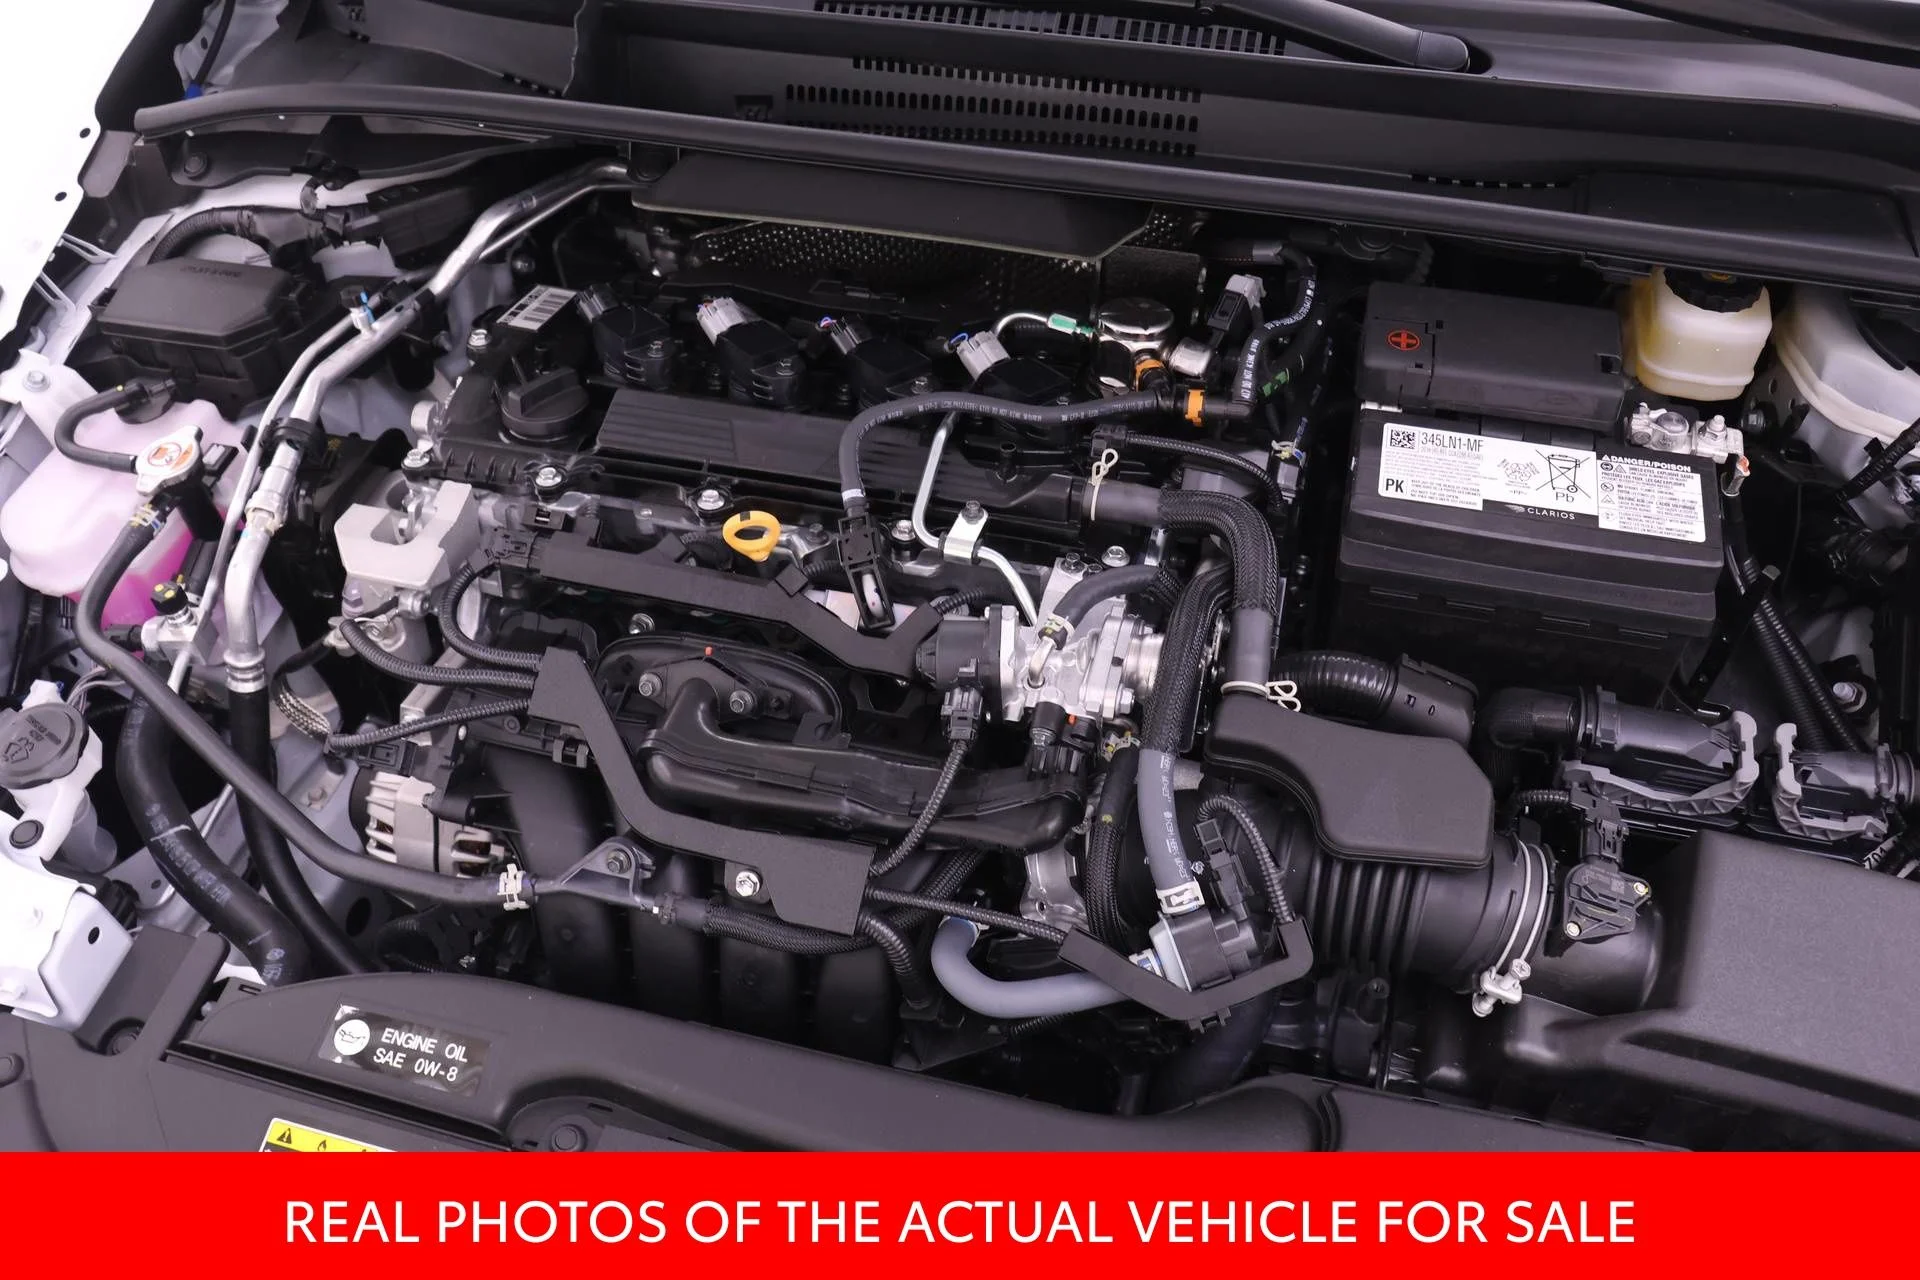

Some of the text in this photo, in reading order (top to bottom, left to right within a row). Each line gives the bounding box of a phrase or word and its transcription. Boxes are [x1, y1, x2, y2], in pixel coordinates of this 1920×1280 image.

[1422, 432, 1484, 452] 345LN1-MF
[1610, 455, 1692, 472] DANGER/POISON
[1386, 478, 1404, 494] PK
[1556, 492, 1574, 503] Pb
[1527, 508, 1576, 520] CLARIOS
[381, 1028, 468, 1062] ENGINE OIL
[374, 1048, 458, 1082] SAE 0W-8
